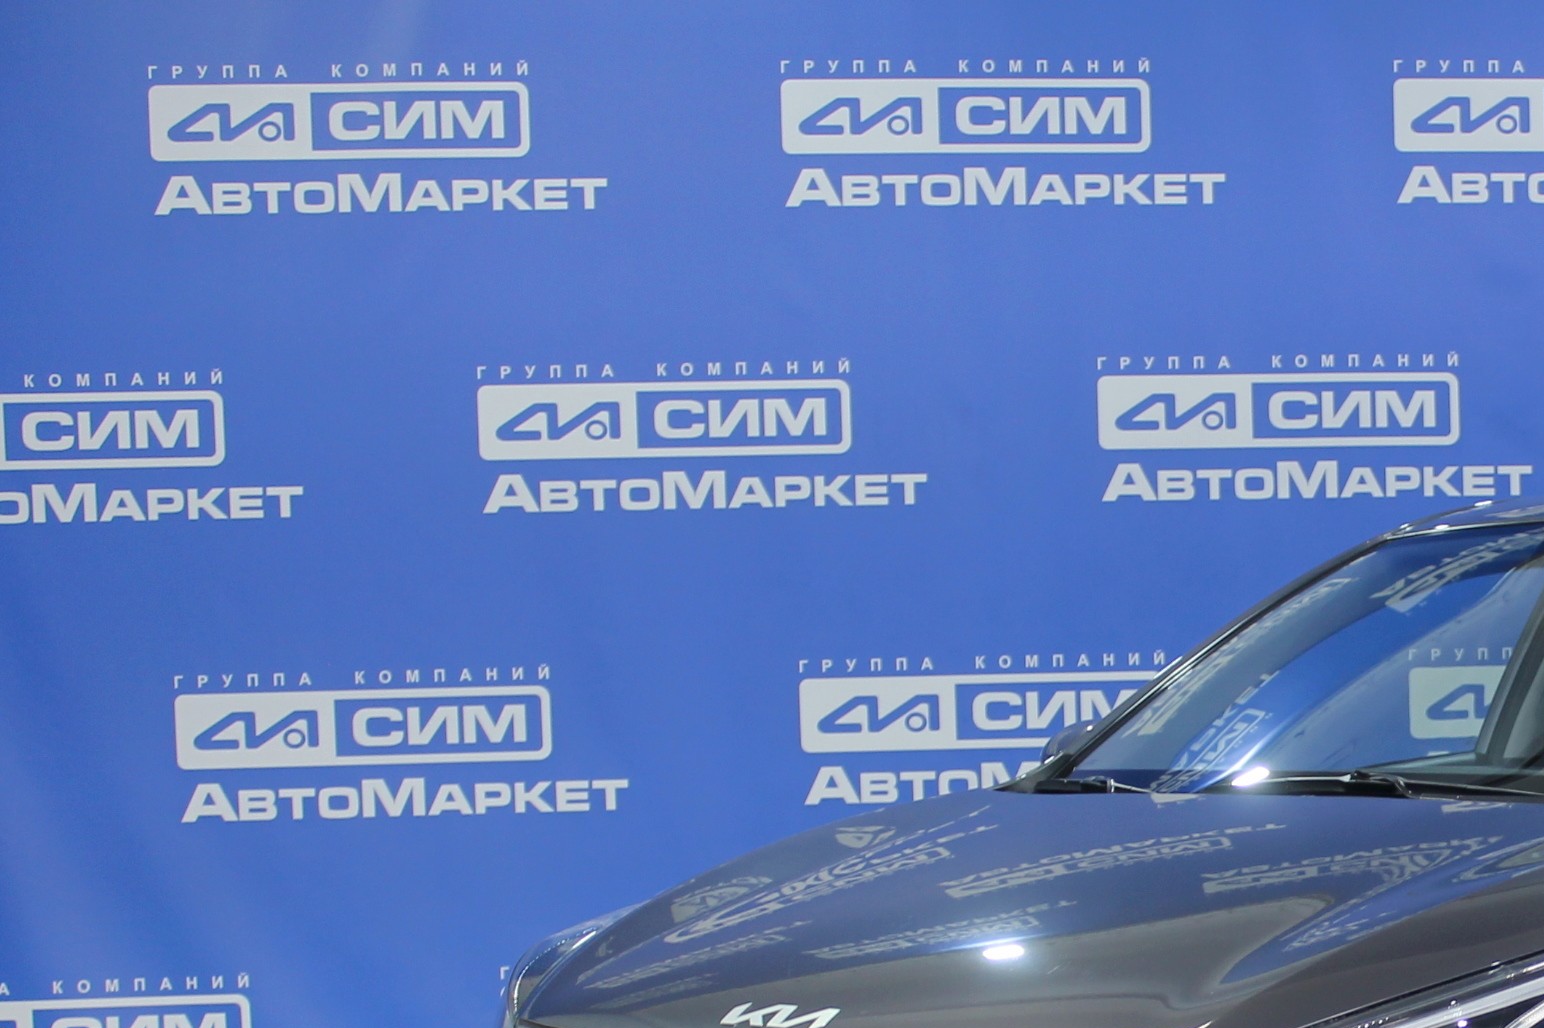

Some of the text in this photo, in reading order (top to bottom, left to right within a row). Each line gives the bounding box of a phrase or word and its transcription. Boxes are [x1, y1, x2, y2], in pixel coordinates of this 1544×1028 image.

[147, 59, 529, 80] ГРУППА КОМПАНИЙ
[779, 57, 1150, 74] ГРУППА КОМПАНИЙ
[1393, 59, 1525, 74] ГРУППА
[328, 99, 505, 141] СИМ
[955, 95, 1127, 135] СИМ
[476, 357, 851, 380] ГРУППА КОМПАНИЙ
[1096, 350, 1459, 371] ГРУППА КОМПАНИЙ
[23, 367, 223, 388] КОМПАНИЙ
[652, 397, 828, 441] СИМ
[1268, 389, 1437, 430] СИМ
[21, 408, 200, 451] СИМ
[798, 649, 1166, 674] ГРУППА КОМПАНИЙ
[173, 663, 551, 690] ГРУППА КОМПАНИЙ
[351, 703, 529, 748] СИМ
[52, 972, 250, 995] КОМПАНИЙ
